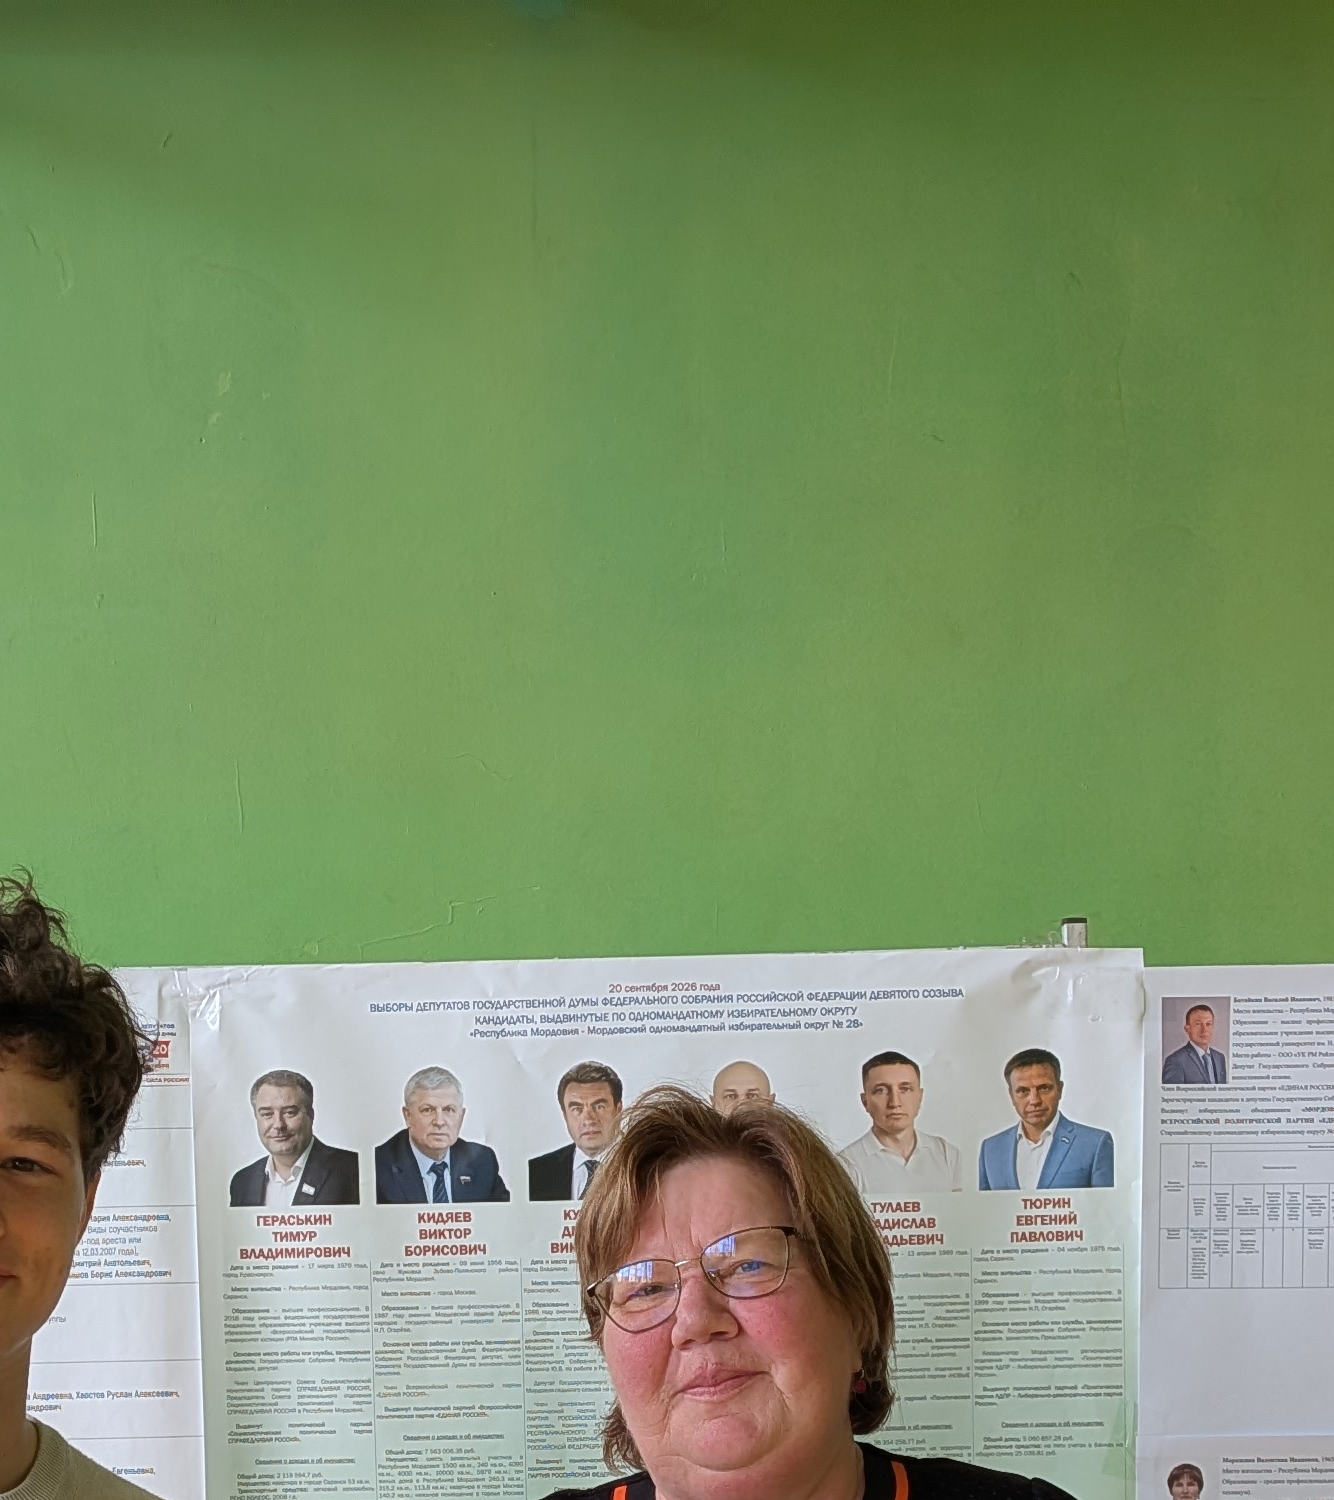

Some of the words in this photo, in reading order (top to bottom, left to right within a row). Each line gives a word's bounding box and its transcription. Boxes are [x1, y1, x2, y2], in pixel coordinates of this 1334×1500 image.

[608, 984, 623, 994] 20
[624, 983, 669, 995] сентября
[671, 982, 697, 992] 2026
[699, 983, 720, 993] года
[369, 1002, 413, 1013] ВЫБОРЫ
[416, 1001, 471, 1013] ДЕПУТАТОВ
[472, 997, 566, 1011] ГОСУДАРСТВЕННОЙ
[568, 997, 599, 1009] ДУМЫ
[601, 995, 679, 1008] ФЕДЕРАЛЬНОГО
[681, 994, 733, 1005] СОБРАНИЯ
[736, 991, 804, 1004] РОССИЙСКОЙ
[807, 990, 867, 1002] ФЕДЕРАЦИИ
[869, 989, 920, 1001] ДЕВЯТОГО
[922, 988, 964, 999] СОЗЫВА
[475, 1014, 537, 1026] КАНДИДАТЫ,
[540, 1012, 609, 1025] ВЫДВИНУТЫЕ
[612, 1011, 626, 1022] ПО
[628, 1009, 725, 1022] ОДНОМАНДАТНОМУ
[727, 1007, 817, 1019] ИЗБИРАТЕЛЬНОМУ
[820, 1006, 857, 1017] ОКРУГУ
[470, 1028, 528, 1040] «Республика
[530, 1026, 579, 1038] Мордовия
[587, 1024, 646, 1036] Мордовский
[649, 1021, 725, 1034] одномандатный
[728, 1021, 802, 1032] избирательный
[804, 1021, 830, 1031] округ
[871, 1201, 921, 1213] ТУЛАЕВ
[1022, 1198, 1071, 1210] ТЮРИН
[256, 1213, 332, 1227] ГЕРАСЬКИН
[417, 1211, 472, 1225] КИДЯЕВ
[874, 1217, 936, 1231] АДИСЛАВ
[1016, 1211, 1077, 1226] ЕВГЕНИЙ
[272, 1230, 317, 1243] ТИМУР
[419, 1227, 471, 1240] ВИКТОР
[884, 1233, 944, 1248] АДЬЕВИЧ
[1010, 1230, 1083, 1243] ПАВЛОВИЧ
[239, 1246, 351, 1261] ВЛАДИМИРОВИЧ
[404, 1243, 487, 1257] БОРИСОВИЧ
